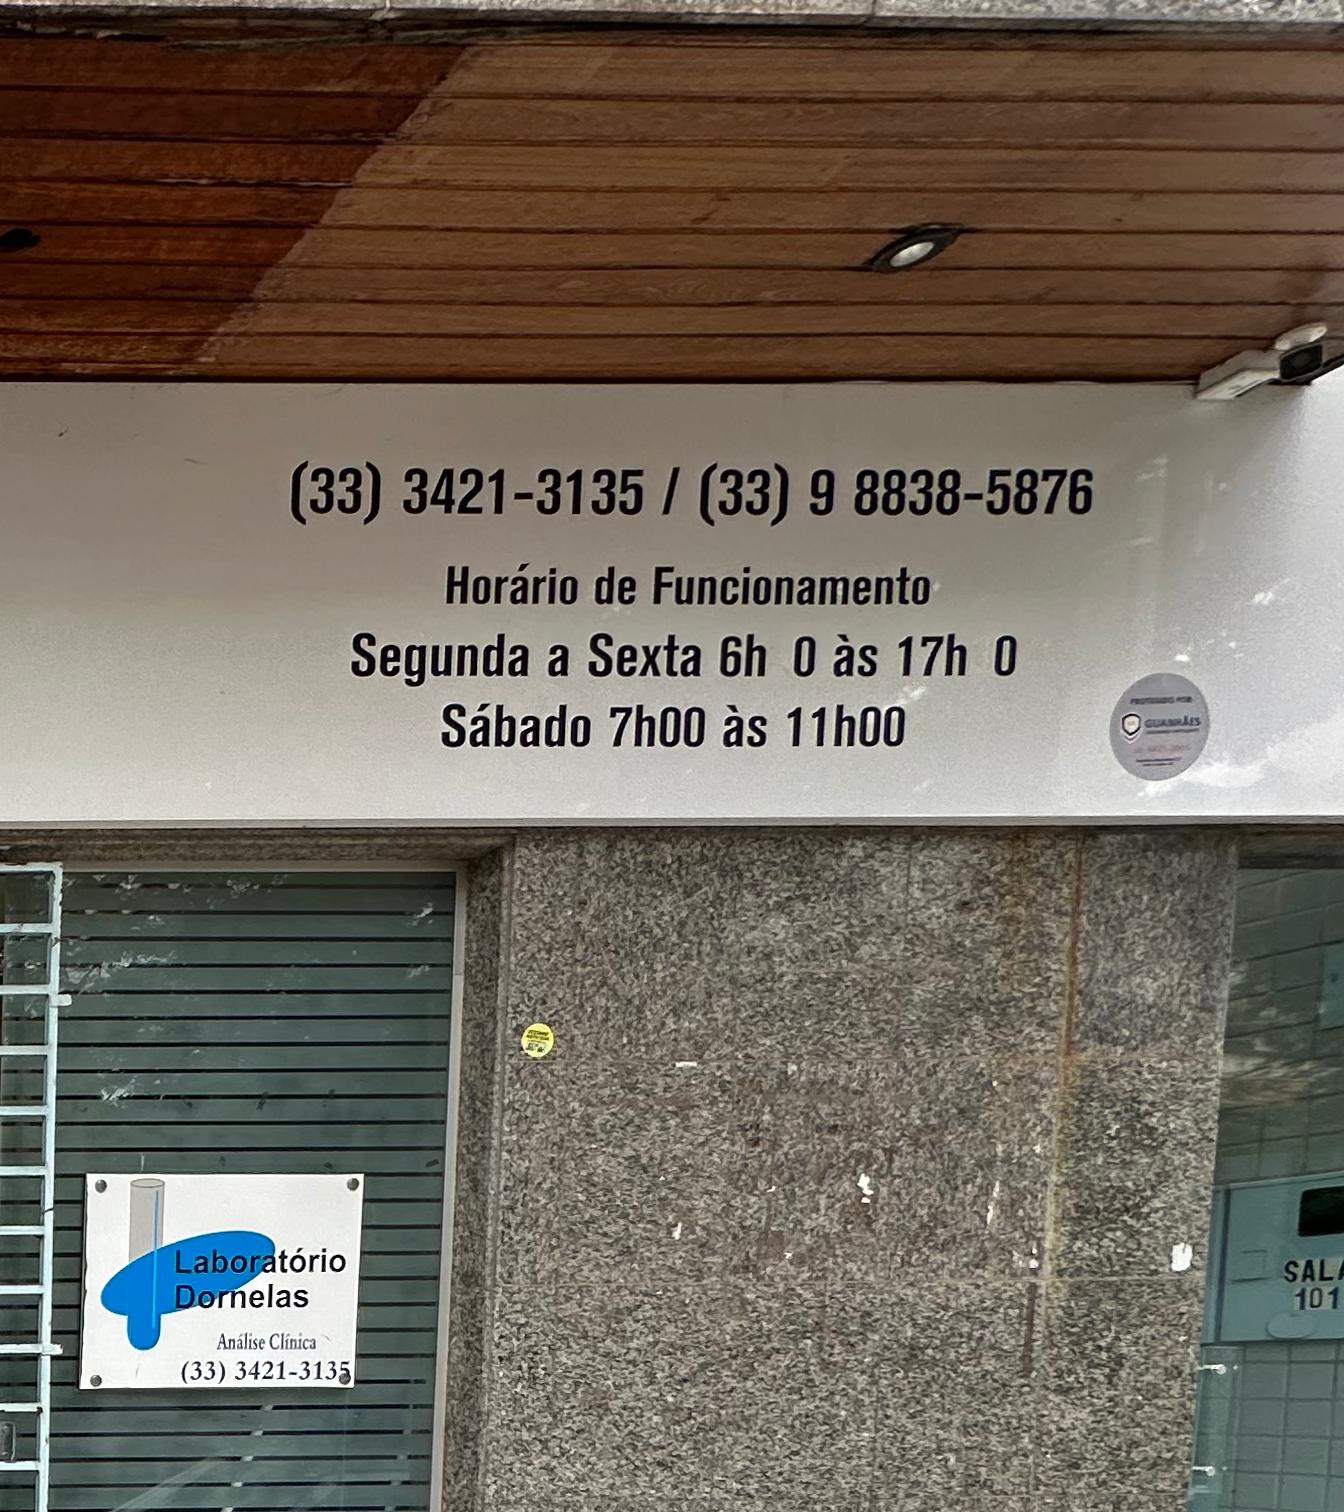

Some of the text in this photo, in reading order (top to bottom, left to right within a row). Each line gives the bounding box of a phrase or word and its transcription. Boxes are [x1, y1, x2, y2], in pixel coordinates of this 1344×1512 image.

[290, 461, 382, 526] (33)
[403, 467, 644, 516] 3421-3135
[700, 463, 789, 527] (33)
[809, 469, 835, 516] 9
[854, 468, 1093, 516] 8838-5876
[445, 562, 930, 606] Horário de Funcionamento
[350, 632, 529, 687] Segunda
[548, 644, 569, 677] a
[588, 633, 701, 677] Sexta
[833, 634, 878, 677] às
[441, 703, 906, 748] Sábado 7h00 às 11h00
[175, 1248, 346, 1274] Laboratório
[175, 1284, 309, 1309] Dornelas
[1295, 1286, 1339, 1310] 101
[217, 1333, 317, 1351] Análise Clínica
[181, 1361, 351, 1384] (33) 3421-3135
